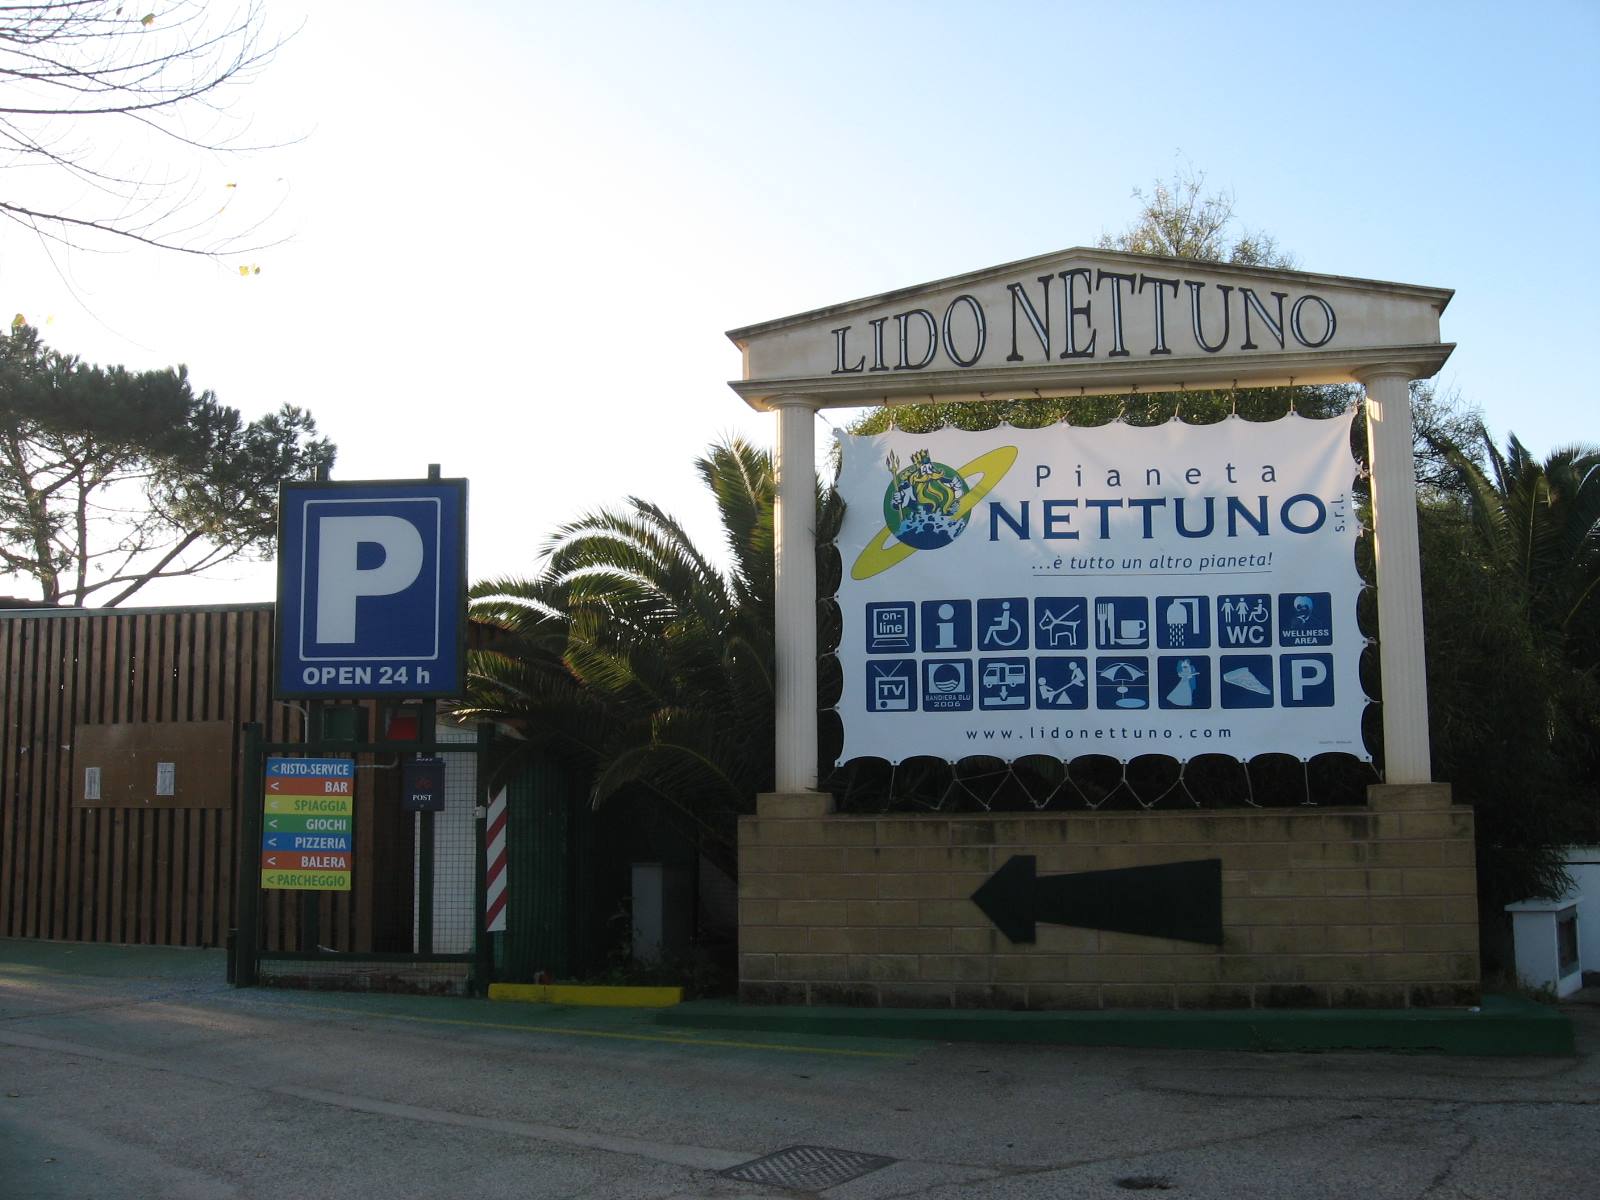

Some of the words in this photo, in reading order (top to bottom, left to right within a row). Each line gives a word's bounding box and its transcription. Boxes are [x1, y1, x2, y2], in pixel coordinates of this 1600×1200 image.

[832, 294, 987, 374] LIDO
[1006, 268, 1337, 361] NETTUNO
[1036, 462, 1276, 487] Pianeta
[989, 493, 1327, 541] NETTUNO
[1331, 494, 1345, 532] s.r.l.
[1071, 556, 1115, 570] tutto
[1122, 558, 1142, 569] un
[1149, 554, 1193, 569] altro
[1200, 552, 1273, 571] pianeta!
[316, 516, 424, 644] P
[882, 611, 902, 621] on-
[879, 622, 903, 634] line
[1282, 629, 1329, 638] WELLNESS
[1226, 626, 1265, 644] WC
[1294, 637, 1318, 645] AREA
[302, 666, 371, 685] OPEN
[379, 666, 408, 685] 24
[416, 666, 429, 685] h
[1291, 659, 1327, 701] P
[880, 684, 904, 696] TV
[925, 694, 957, 702] BANDIERA
[966, 727, 1232, 740] www.lidonettuno.com
[280, 764, 349, 775] RISTO-SERVICE
[325, 781, 348, 793] BAR
[294, 800, 347, 811] SPIAGGIA
[306, 819, 346, 831] GIOCHI
[295, 837, 346, 849] PIZZERIA
[301, 856, 346, 868] BALERA
[277, 875, 345, 887] PARCHEGGIO
